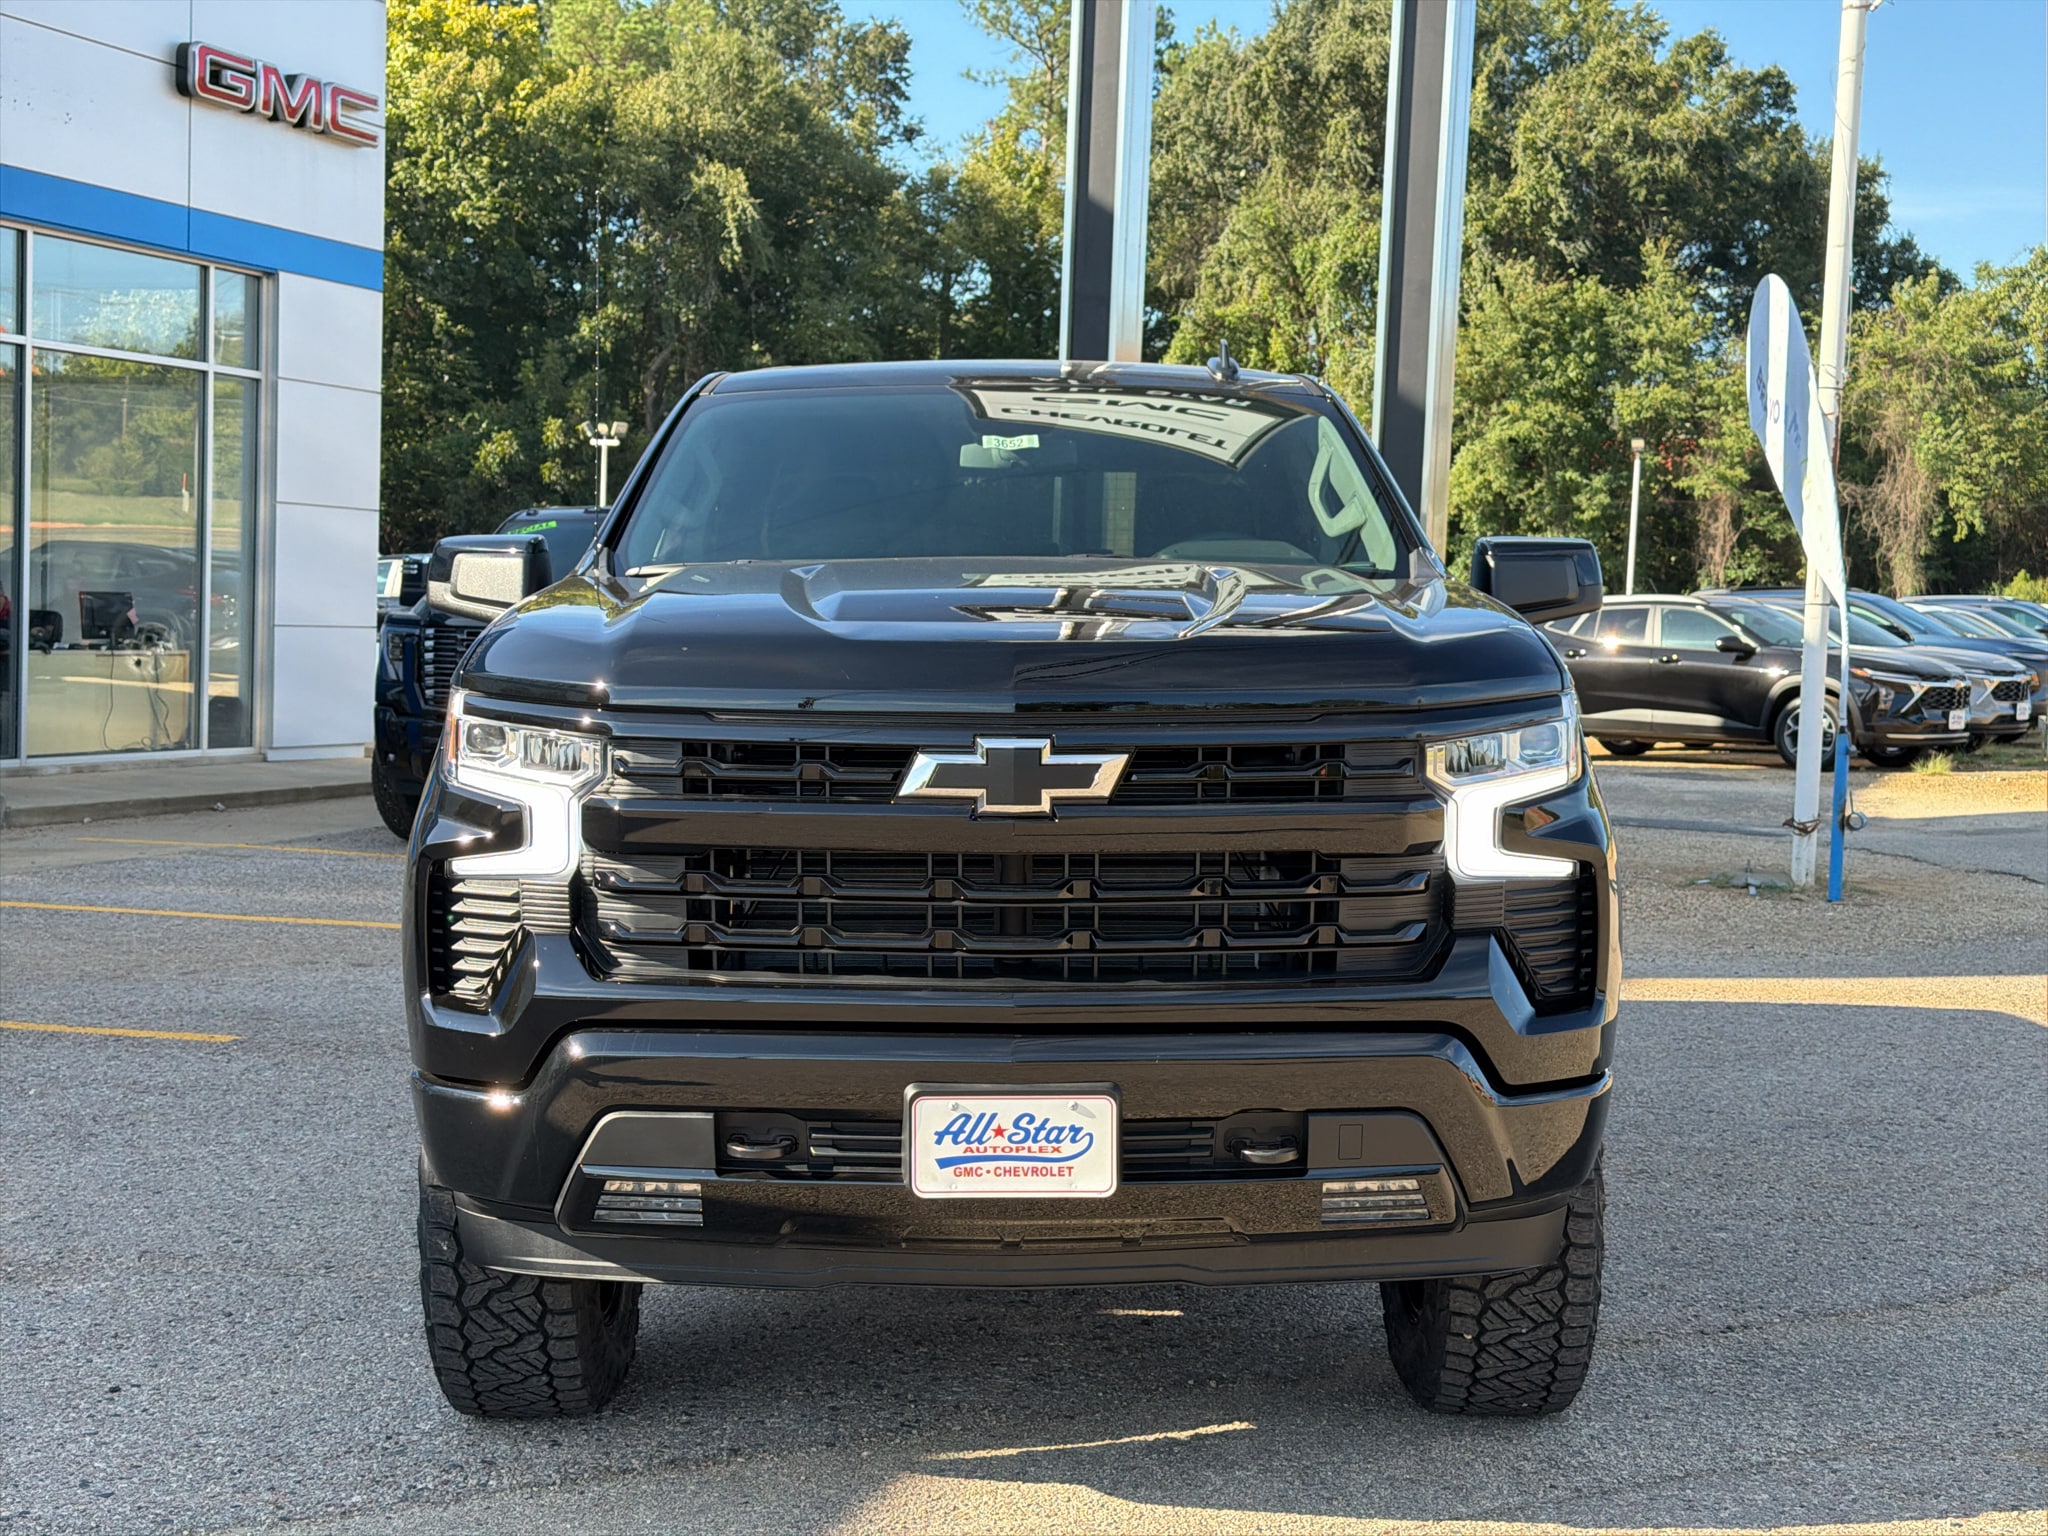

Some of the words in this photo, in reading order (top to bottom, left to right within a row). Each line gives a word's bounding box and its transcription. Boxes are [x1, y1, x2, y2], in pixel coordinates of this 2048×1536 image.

[188, 42, 378, 147] GMC
[994, 438, 1023, 448] 3652
[934, 1112, 998, 1145] All
[1007, 1112, 1084, 1144] Star
[953, 1167, 983, 1177] GMC
[993, 1166, 1074, 1177] CHEVROLET
